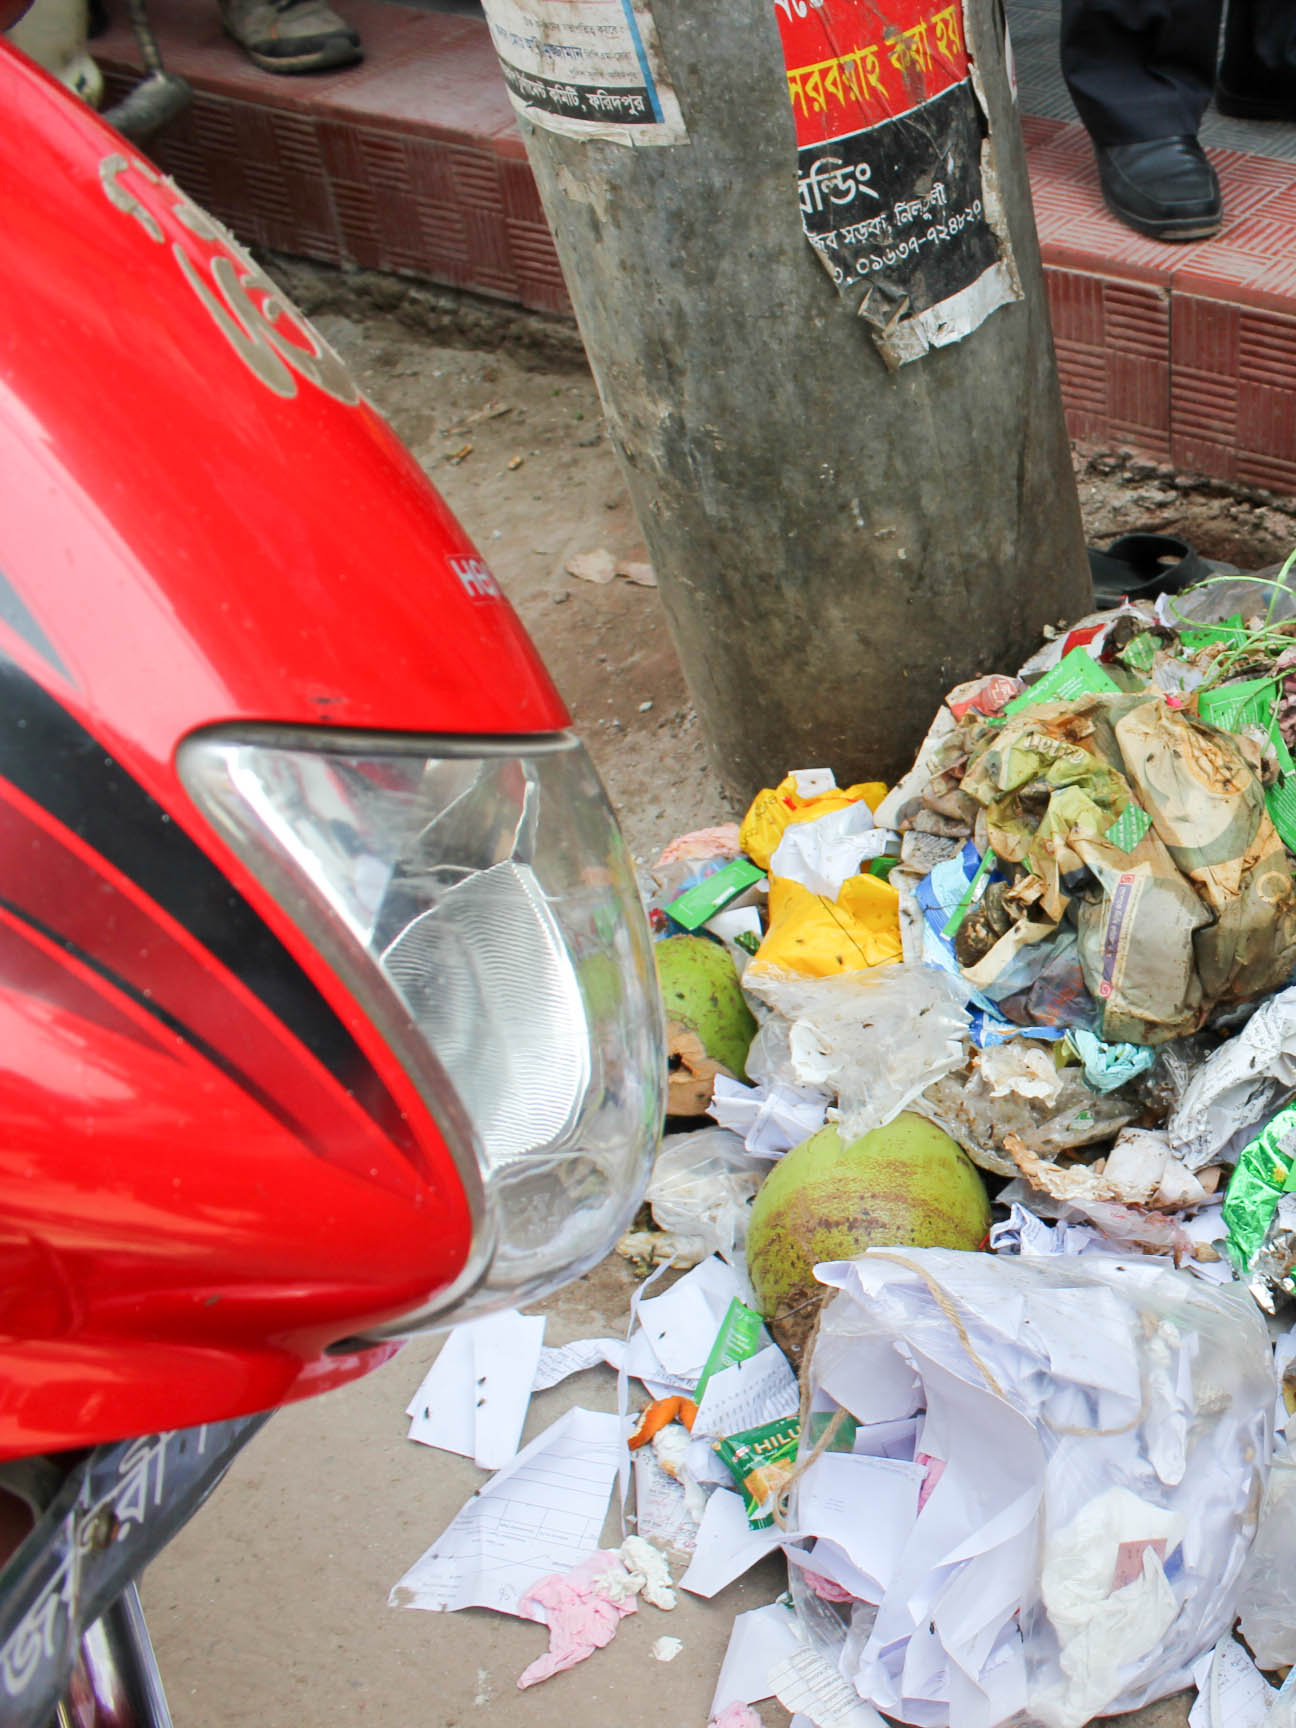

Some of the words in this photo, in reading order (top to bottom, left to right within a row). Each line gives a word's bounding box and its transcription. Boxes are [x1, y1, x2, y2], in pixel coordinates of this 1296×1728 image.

[786, 44, 889, 118] সরবরাহ
[884, 16, 933, 73] করা
[931, 5, 961, 64] হয়
[585, 89, 645, 117] ফরিদপুর
